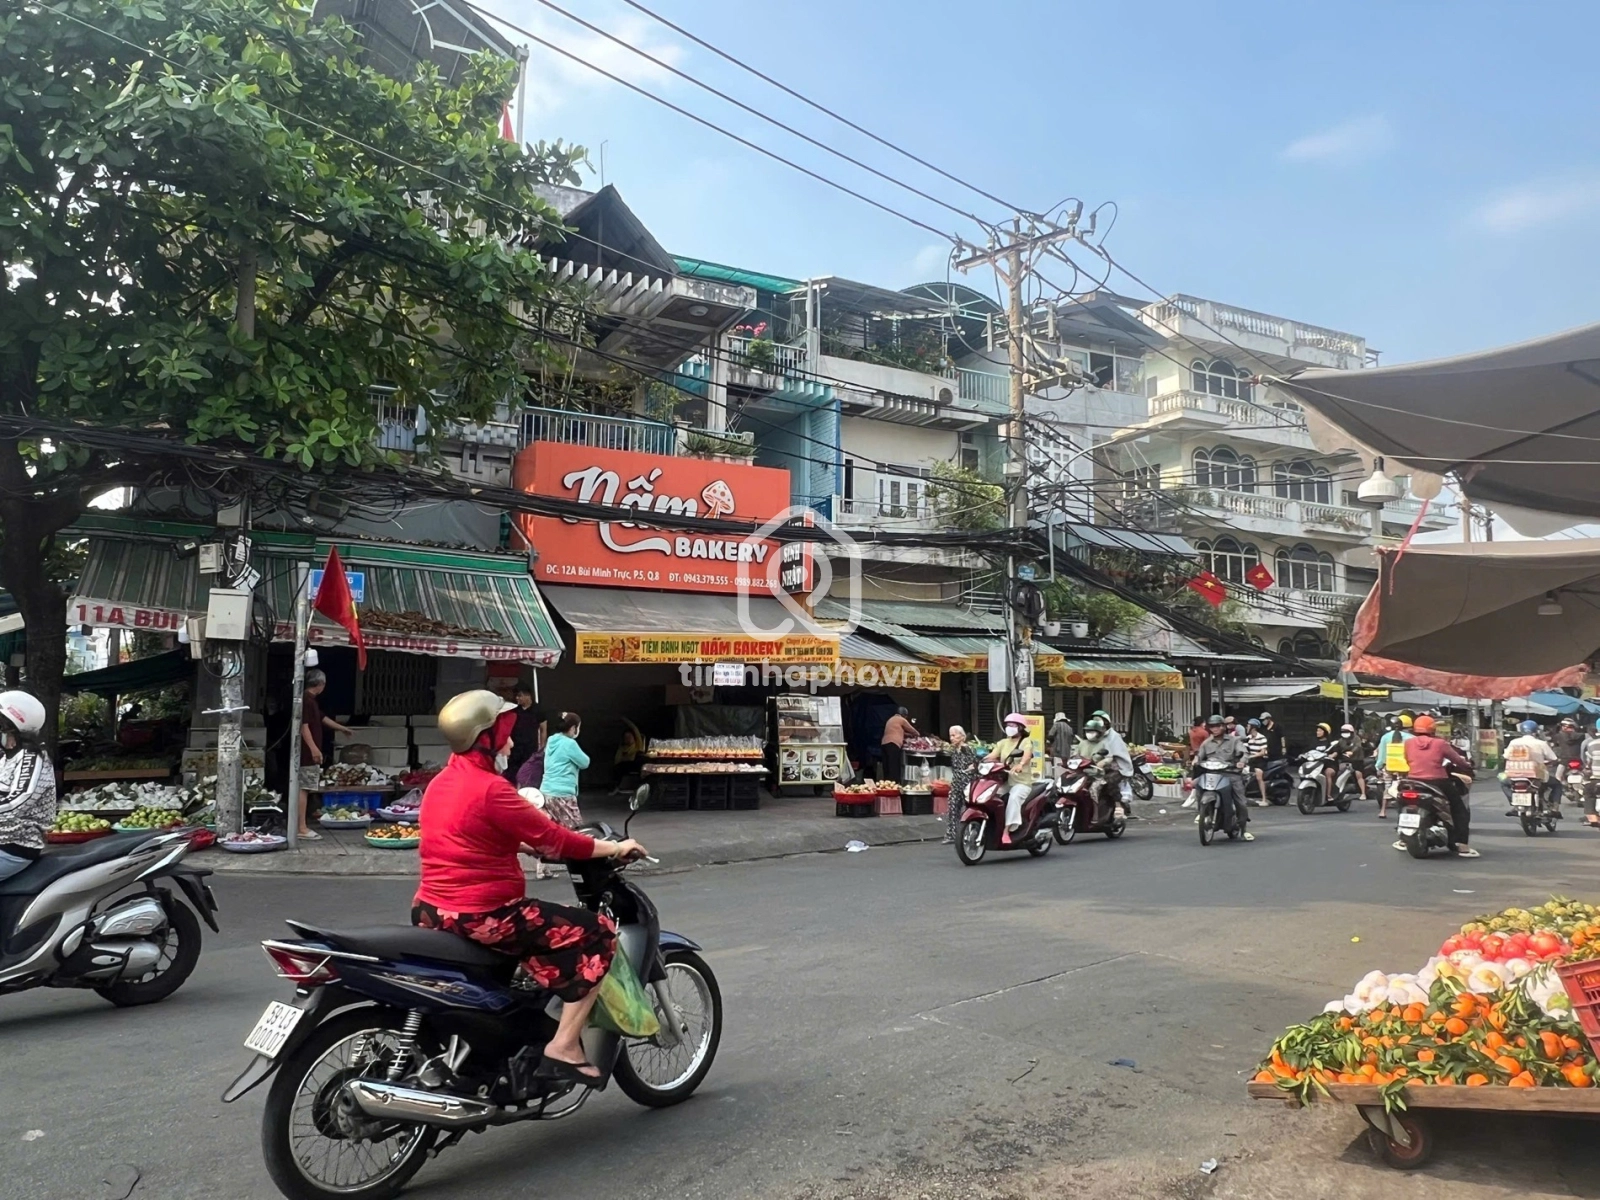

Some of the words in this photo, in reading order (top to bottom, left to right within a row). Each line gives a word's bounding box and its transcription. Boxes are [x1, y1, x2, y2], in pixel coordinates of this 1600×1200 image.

[675, 536, 769, 564] BAKERY
[783, 543, 801, 563] SINH
[546, 564, 560, 575] ĐC:
[561, 565, 577, 577] 12A
[578, 565, 591, 578] Bùi
[592, 567, 612, 579] Minh
[781, 564, 802, 590] NHẬT
[76, 604, 125, 625] 11A
[660, 637, 680, 655] BÁNH
[733, 641, 784, 656] BAKERY
[249, 1025, 286, 1053] 00007
